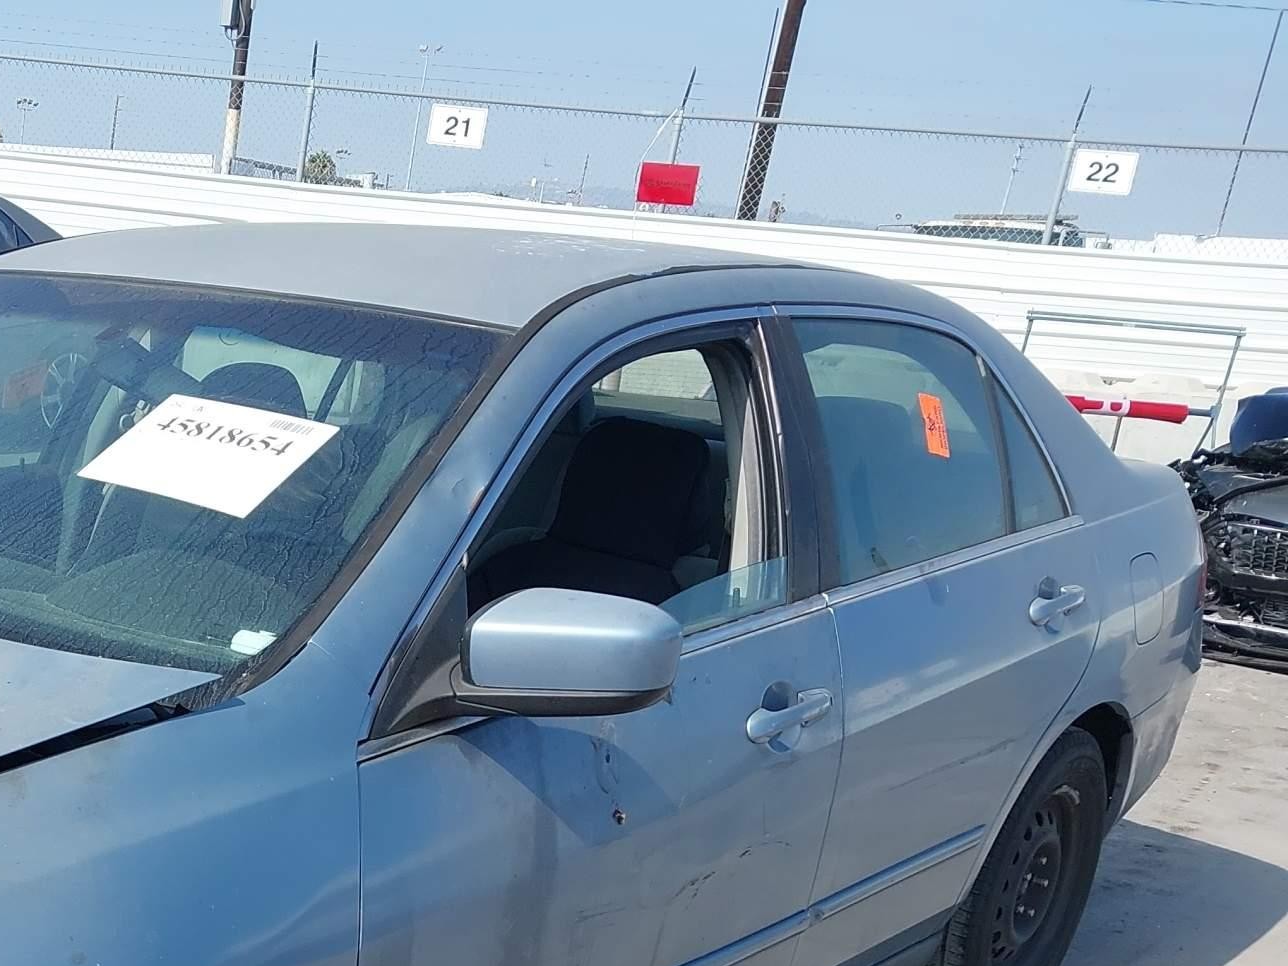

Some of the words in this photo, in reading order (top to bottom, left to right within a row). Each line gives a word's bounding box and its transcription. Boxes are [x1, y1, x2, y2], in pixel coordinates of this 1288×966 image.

[443, 116, 471, 137] 21
[1086, 161, 1120, 183] 22
[156, 415, 295, 457] 45818654
